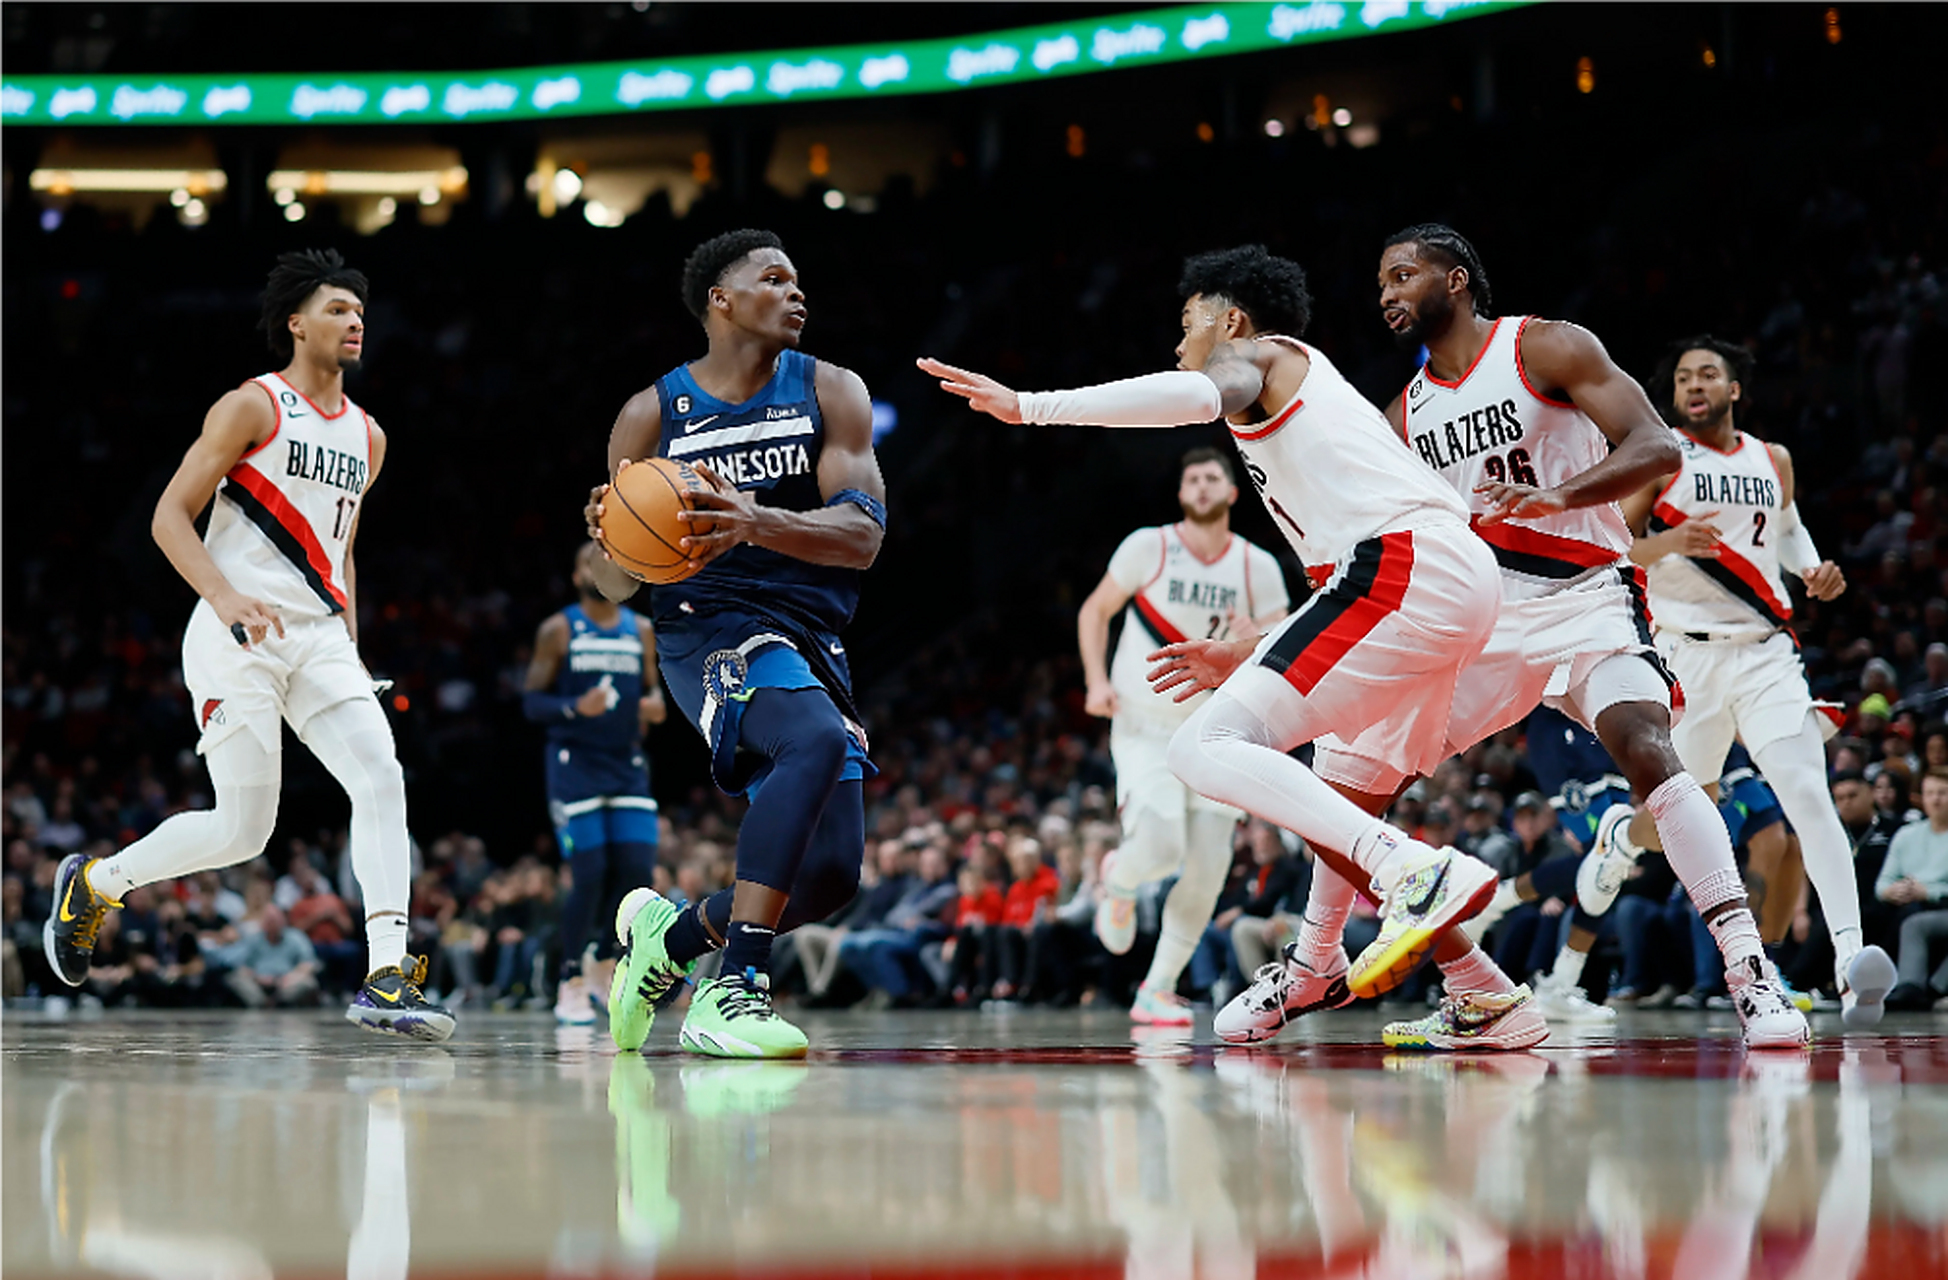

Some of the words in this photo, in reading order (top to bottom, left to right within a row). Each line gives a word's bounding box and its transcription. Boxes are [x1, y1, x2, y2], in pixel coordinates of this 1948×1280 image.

[676, 396, 690, 413] 6
[1414, 398, 1524, 471] BLAZERS
[287, 439, 366, 495] BLAZERS
[1694, 472, 1776, 508] BLAZERS
[1751, 511, 1767, 548] 2
[1168, 578, 1238, 610] BLAZERS
